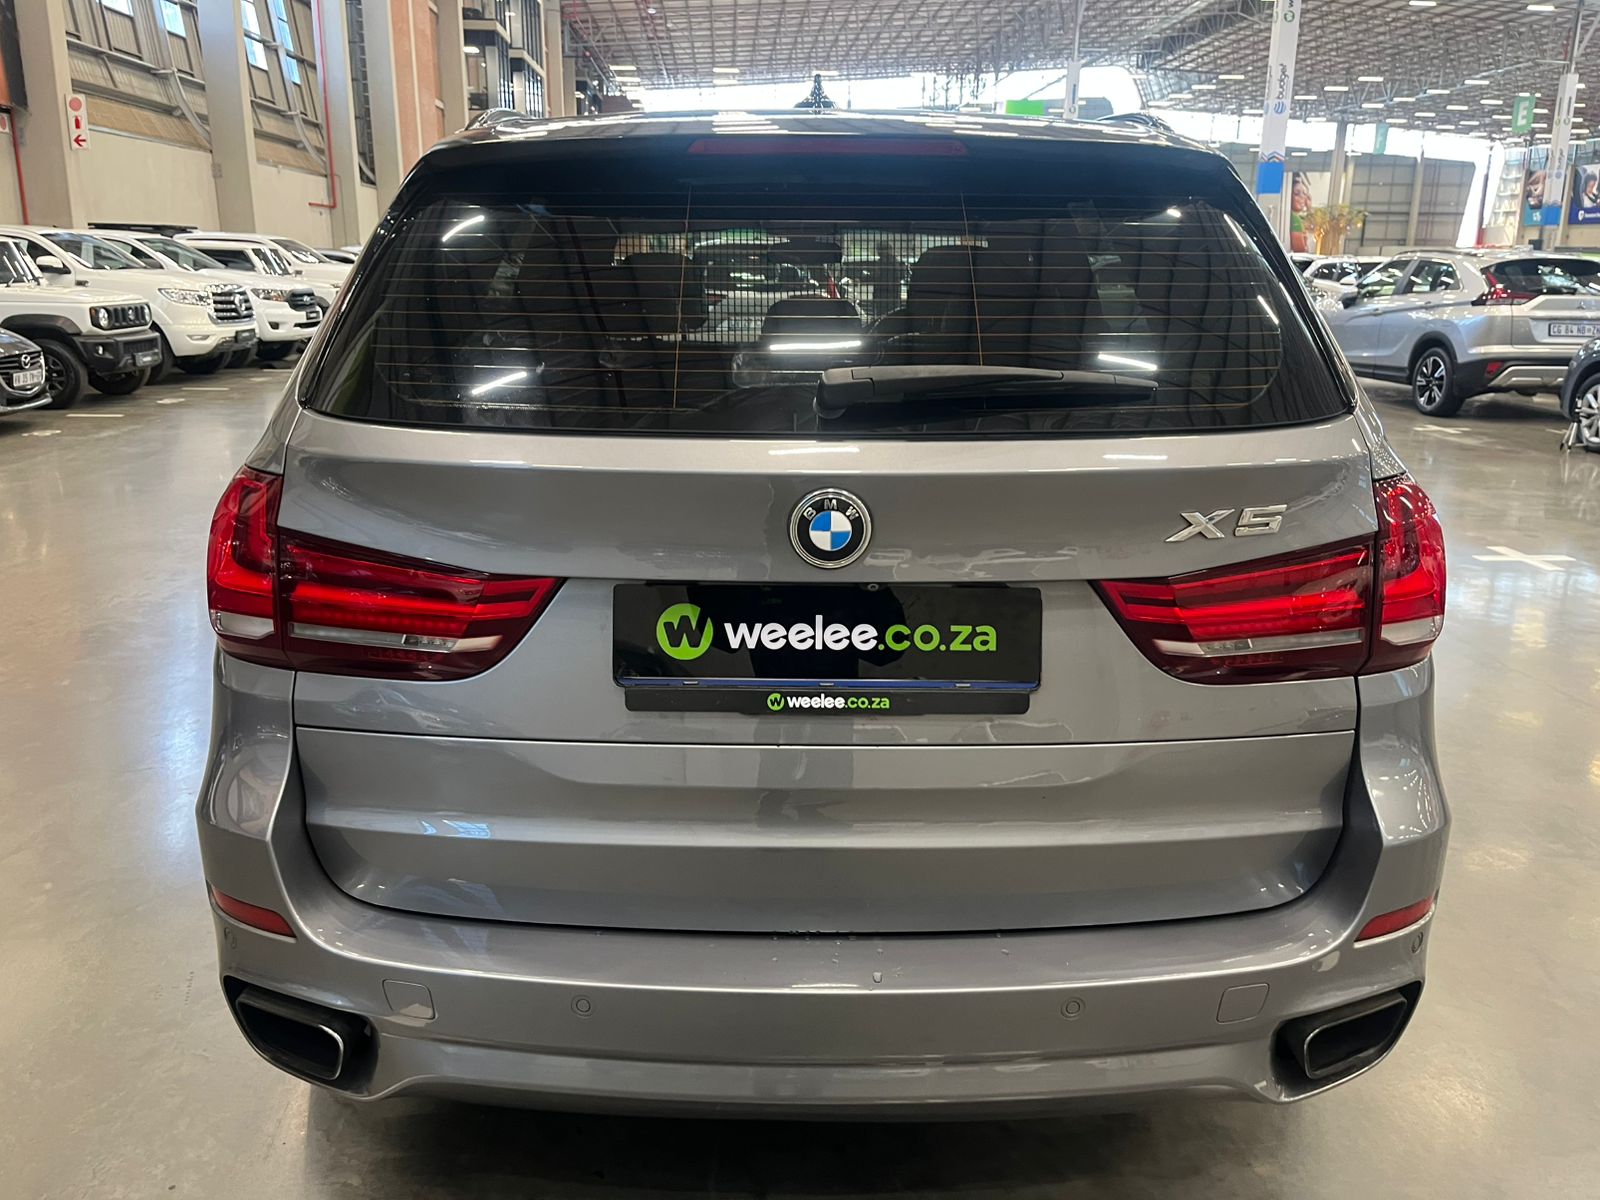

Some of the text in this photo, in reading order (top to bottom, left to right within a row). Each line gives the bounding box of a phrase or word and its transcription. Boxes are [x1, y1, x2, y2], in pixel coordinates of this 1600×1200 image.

[1516, 100, 1530, 127] E
[803, 498, 860, 521] BMW
[1164, 504, 1288, 542] X5
[724, 614, 997, 652] weelee.co.za
[787, 693, 890, 709] weelee.co.za
